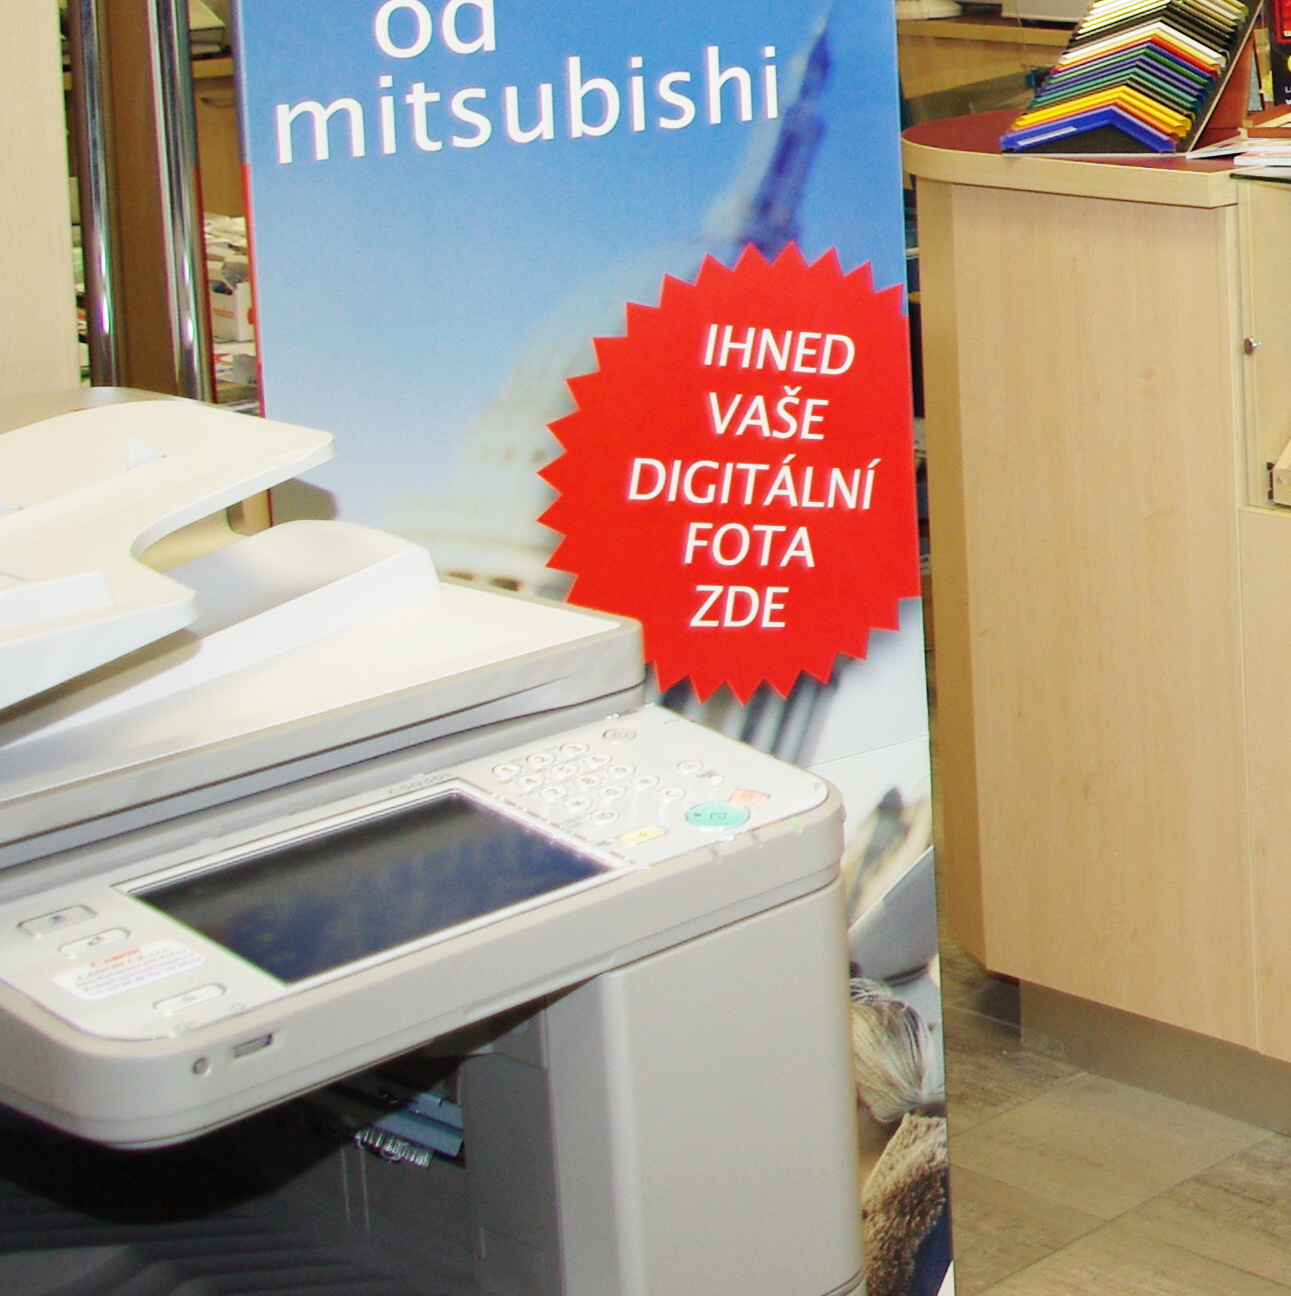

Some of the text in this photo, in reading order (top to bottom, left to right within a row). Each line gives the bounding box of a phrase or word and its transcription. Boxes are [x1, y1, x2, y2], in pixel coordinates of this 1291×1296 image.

[275, 45, 779, 165] mitsubishi
[704, 324, 855, 375] IHNED
[709, 386, 829, 440] VAŠE
[628, 454, 881, 510] DIGITÁLNÍ
[684, 522, 815, 567] FOTA
[690, 585, 789, 628] ZDE
